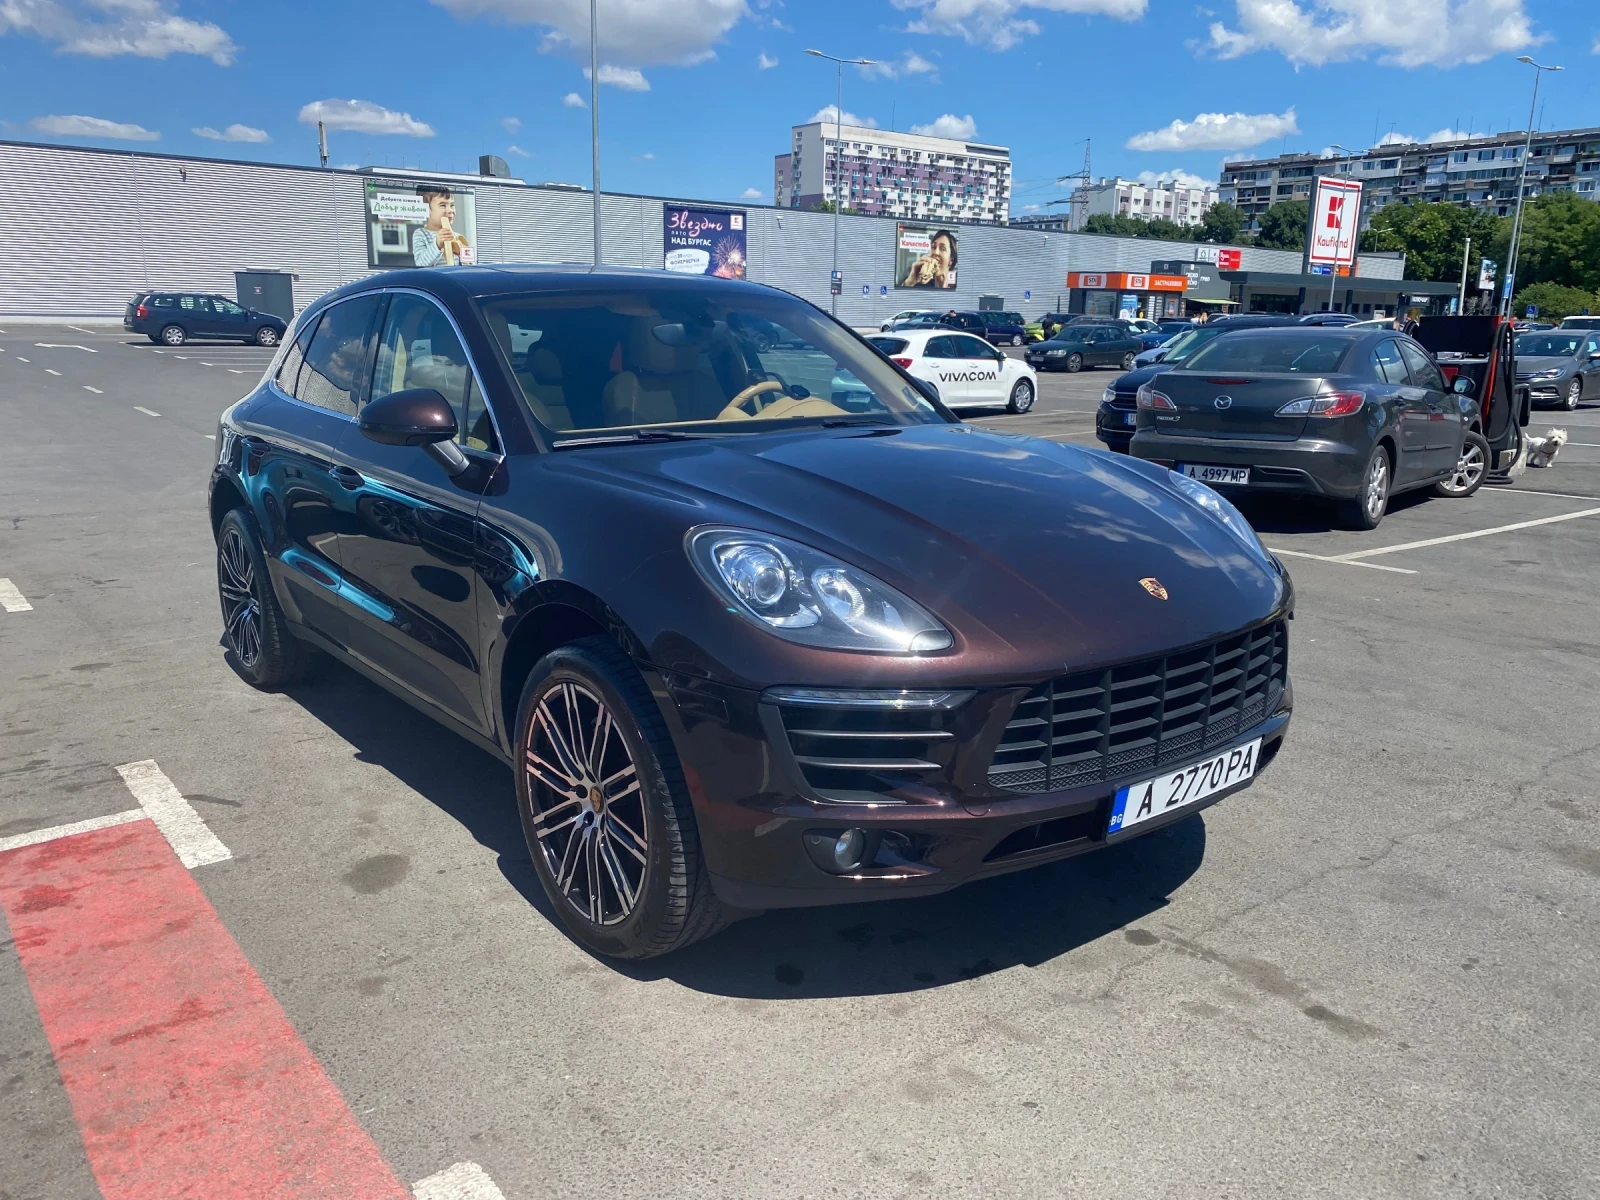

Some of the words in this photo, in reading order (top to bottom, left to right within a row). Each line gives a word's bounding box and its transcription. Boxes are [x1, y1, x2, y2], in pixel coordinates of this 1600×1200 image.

[373, 202, 398, 212] Добър
[667, 210, 723, 237] Звездно
[671, 237, 687, 246] НАД
[688, 238, 712, 246] БУРГАС
[901, 240, 930, 248] Качество
[1316, 235, 1349, 249] Kaufland
[939, 372, 997, 382] VIVACOM
[1189, 467, 1196, 478] A
[1136, 783, 1153, 819] A
[1110, 813, 1123, 826] BG
